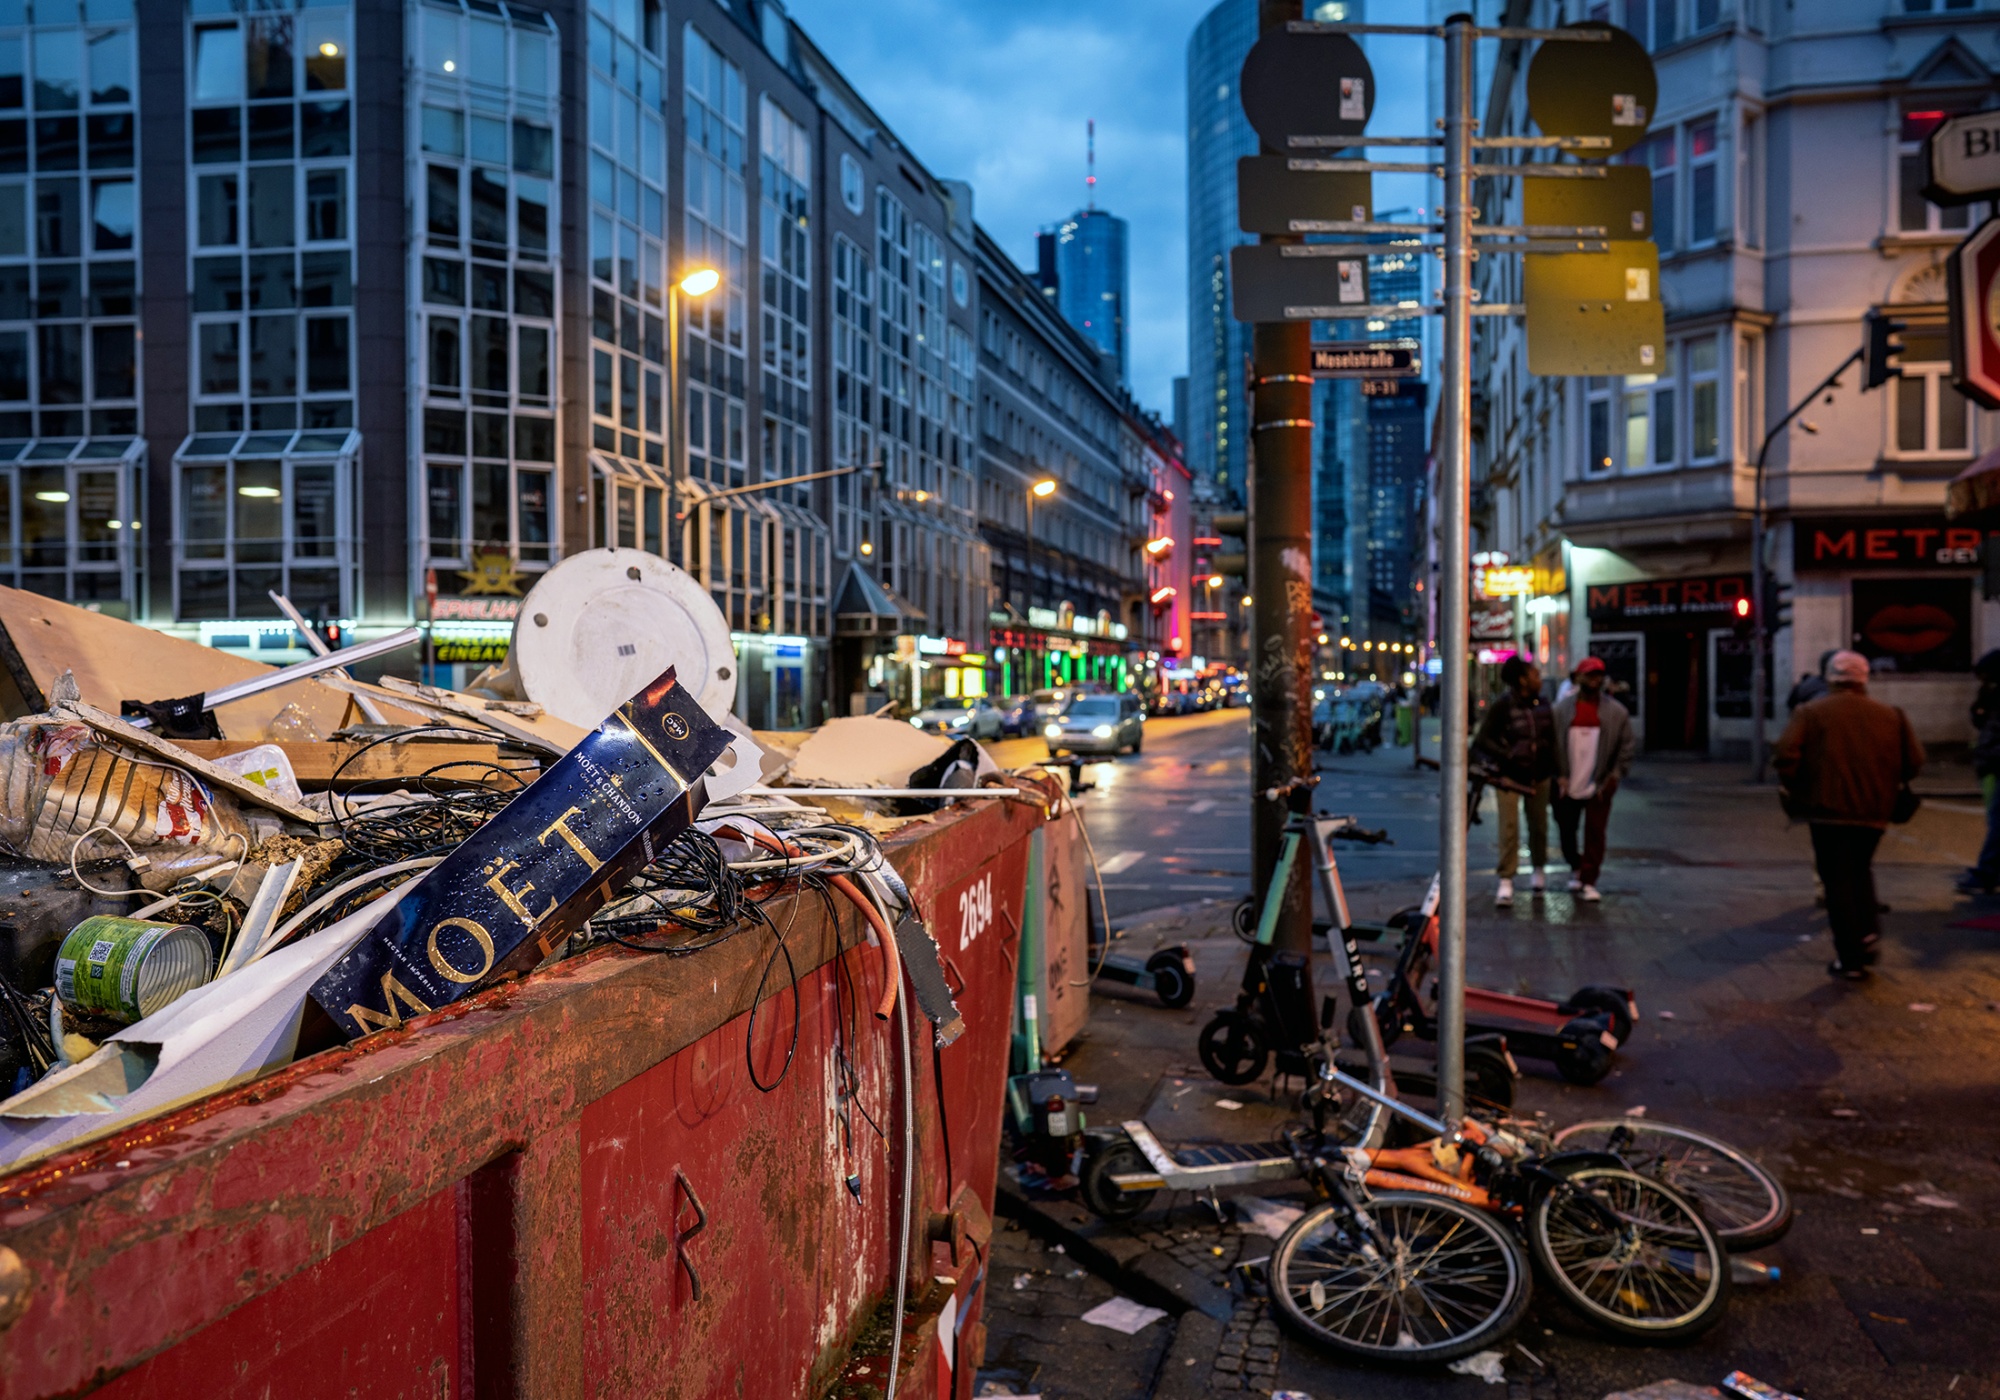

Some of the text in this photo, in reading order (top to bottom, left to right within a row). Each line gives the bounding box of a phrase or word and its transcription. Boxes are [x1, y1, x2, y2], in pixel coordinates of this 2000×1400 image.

[1814, 528, 2000, 560] METR
[432, 599, 522, 619] SPIELHA
[1590, 577, 1746, 609] METRO
[602, 783, 642, 825] CHANDON
[345, 806, 606, 1035] MOËT
[959, 872, 992, 951] 2694
[383, 937, 437, 996] NECTAR IMPÉRIAL
[1346, 938, 1368, 992] BIRD
